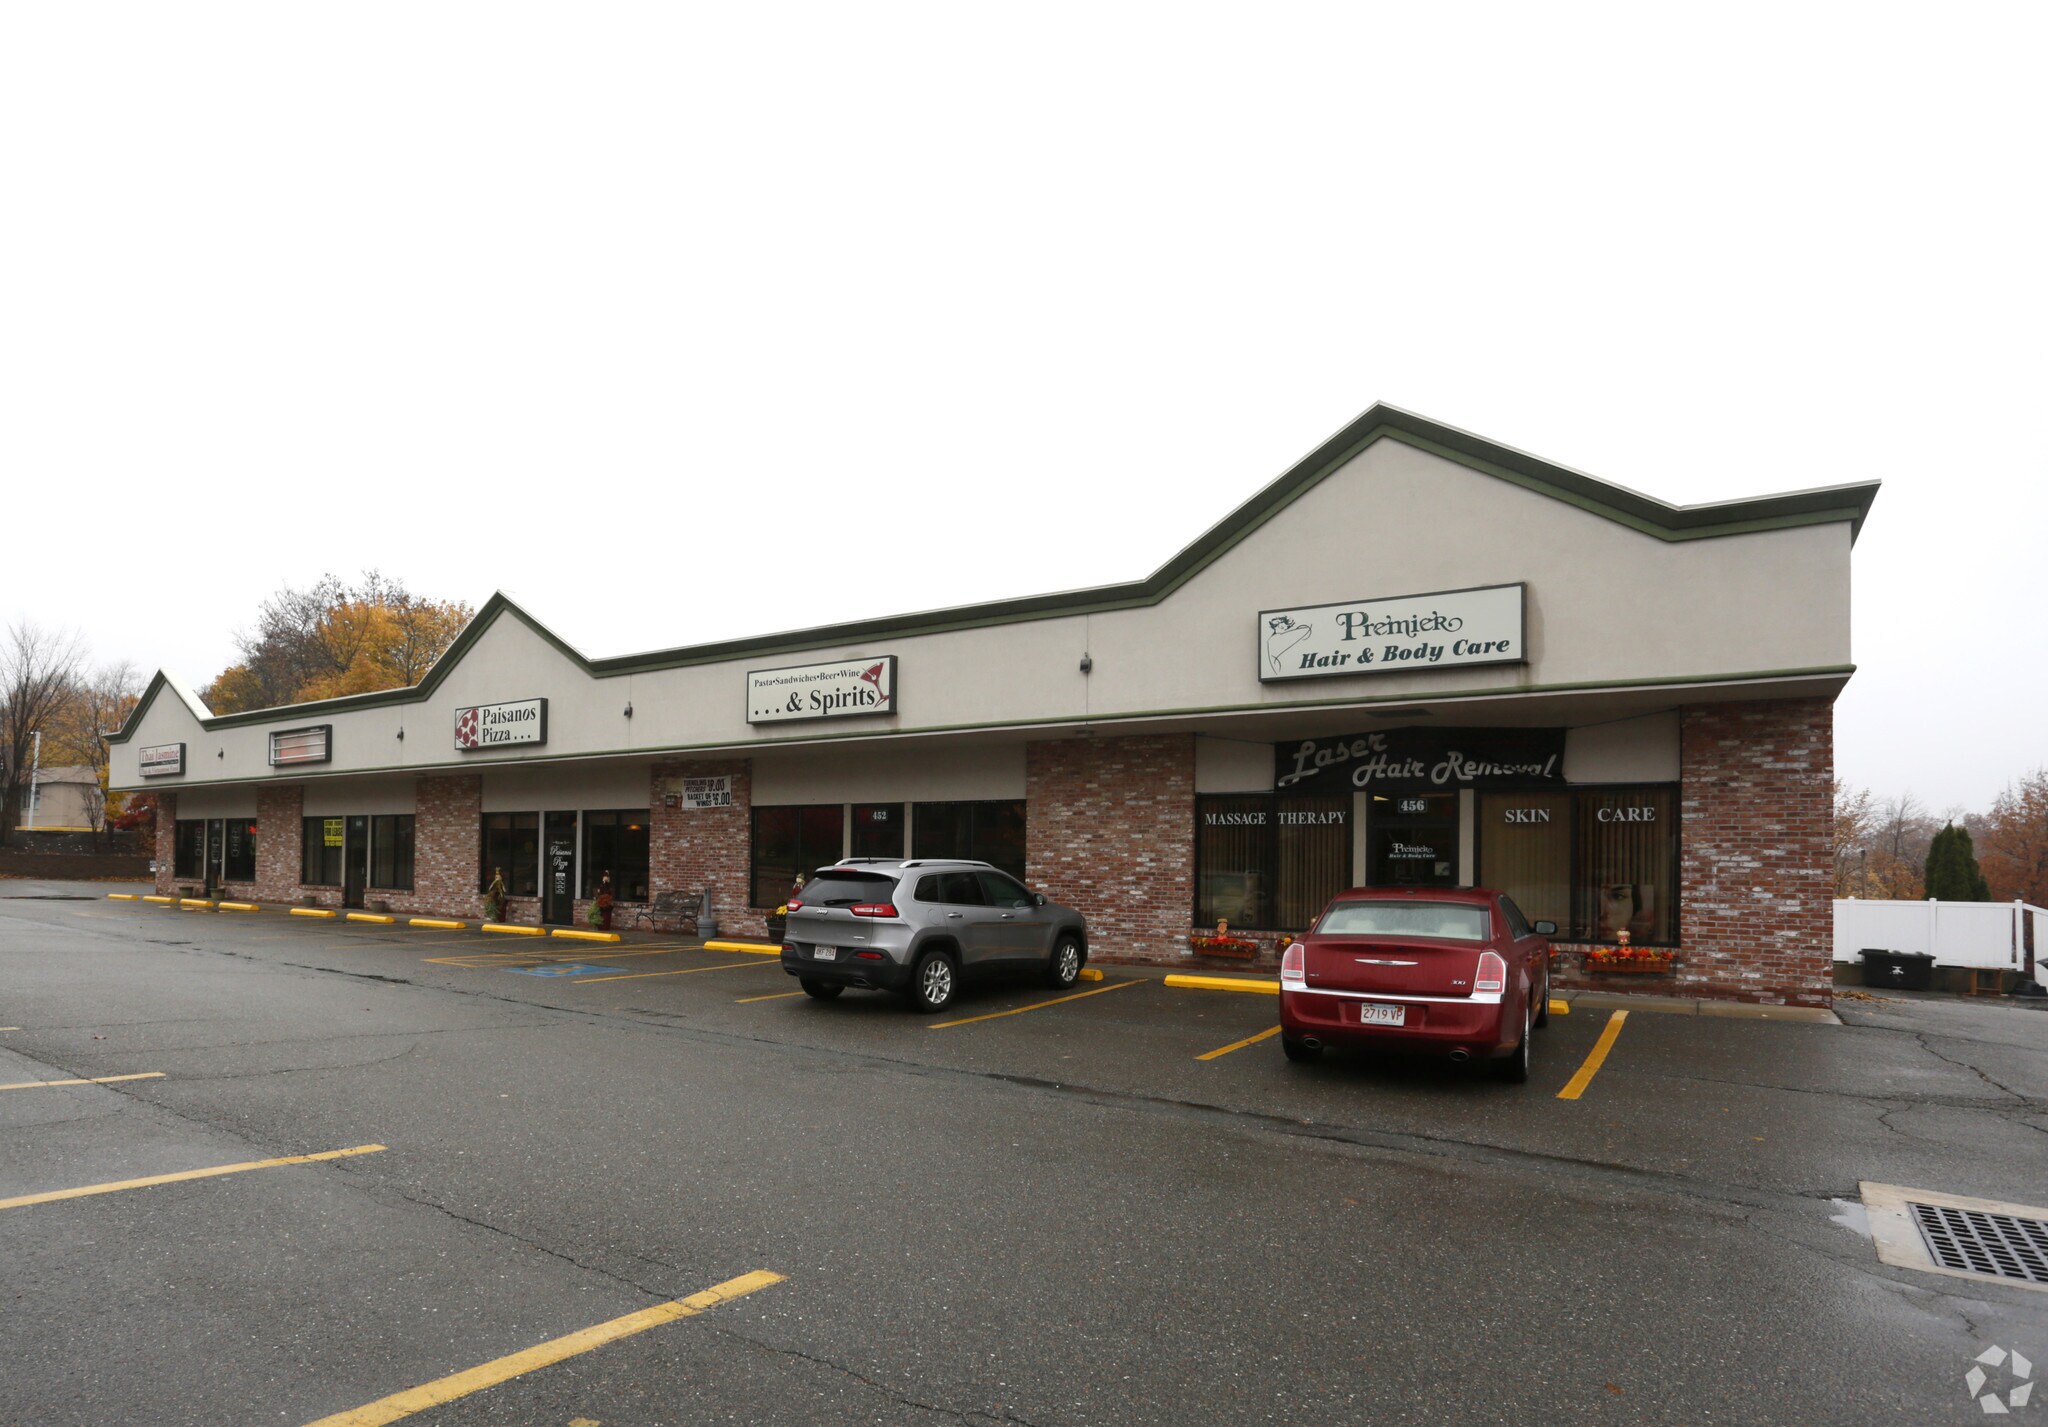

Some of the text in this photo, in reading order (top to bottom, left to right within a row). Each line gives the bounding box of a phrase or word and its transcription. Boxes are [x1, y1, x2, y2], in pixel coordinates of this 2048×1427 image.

[1299, 638, 1510, 669] Hair & Body Care
[754, 669, 861, 687] Pasta Sandwiches Beer Wine
[786, 692, 803, 713] &
[809, 686, 875, 715] Spirits
[482, 707, 536, 726] Paisanos
[482, 727, 511, 743] Pizza
[141, 749, 155, 762] Thai
[1278, 733, 1388, 787] Laser
[1352, 751, 1556, 787] Hair Removal
[1401, 800, 1424, 811] 456
[872, 811, 887, 820] 452
[1205, 811, 1346, 825] MASSAGE THERAPY
[1504, 807, 1655, 823] SKIN CARE
[1363, 1008, 1402, 1021] 2719 VP
